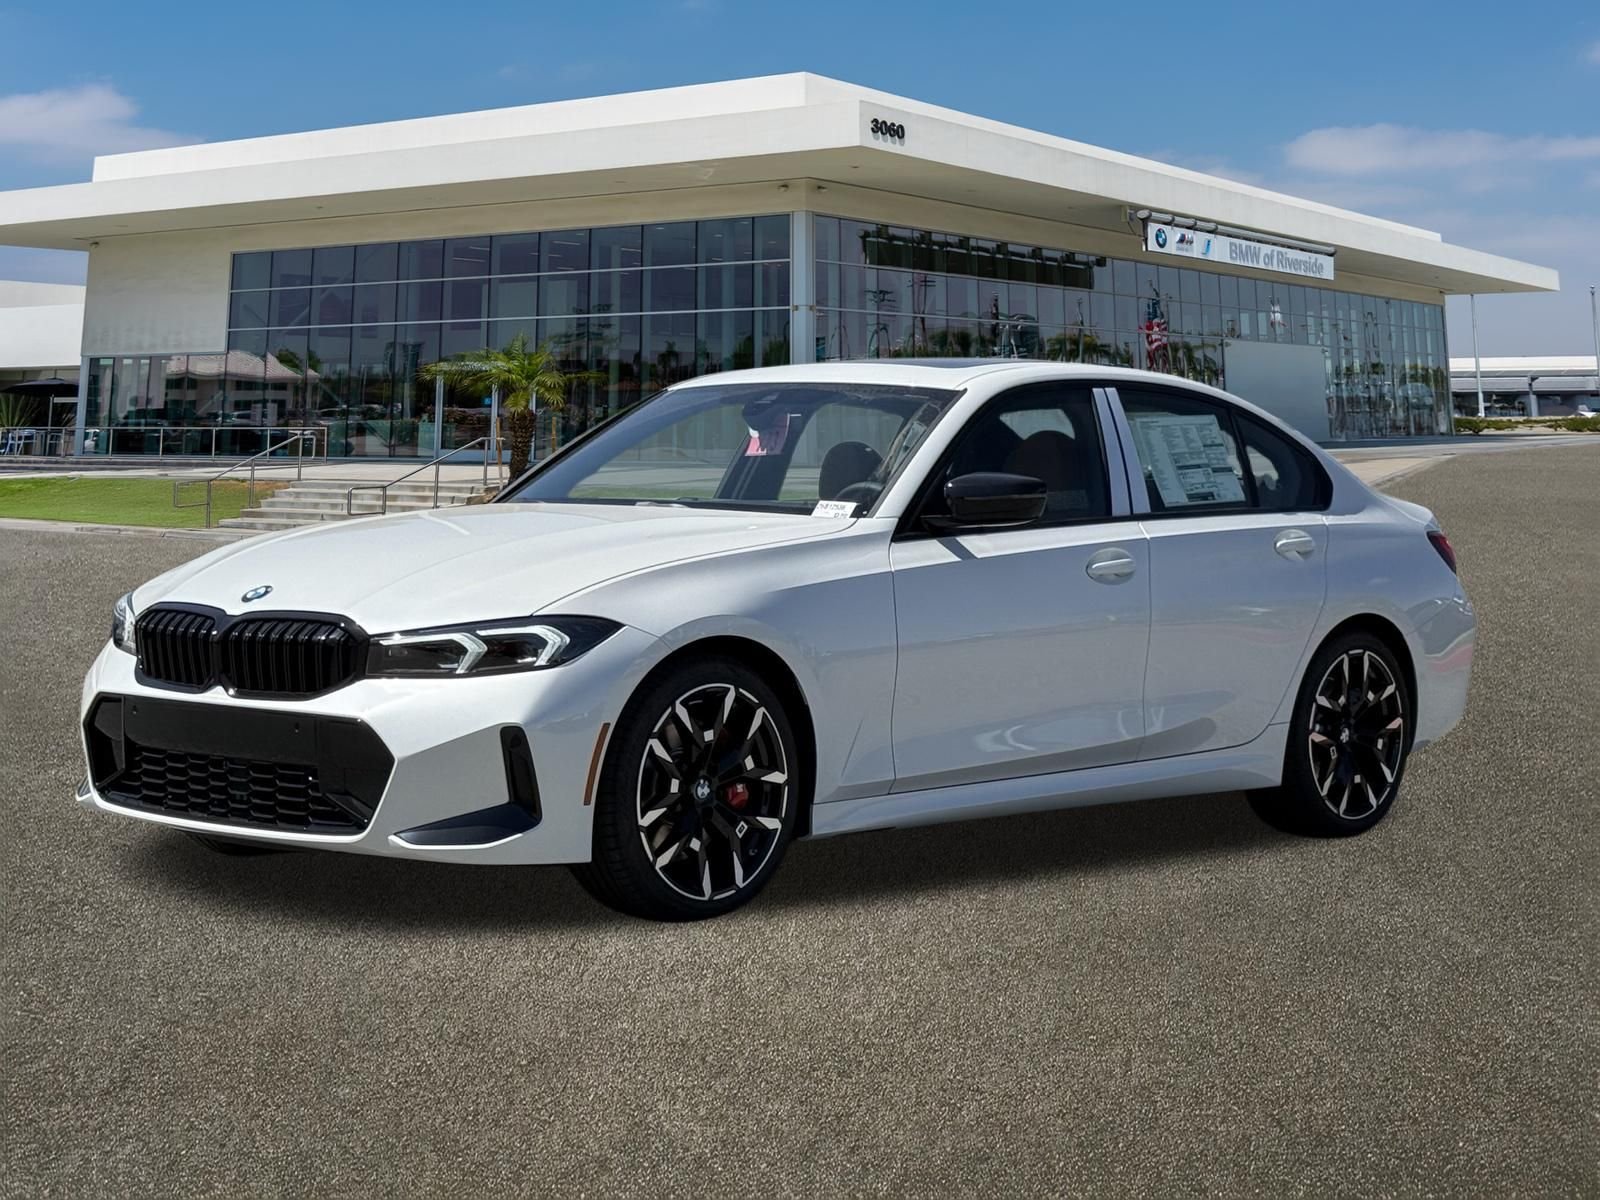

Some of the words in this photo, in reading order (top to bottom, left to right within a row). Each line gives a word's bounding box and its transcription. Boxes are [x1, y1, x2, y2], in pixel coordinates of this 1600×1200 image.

[871, 118, 905, 139] 3060
[1229, 241, 1261, 265] BMW
[1263, 249, 1275, 267] of
[1277, 250, 1325, 275] Riverside
